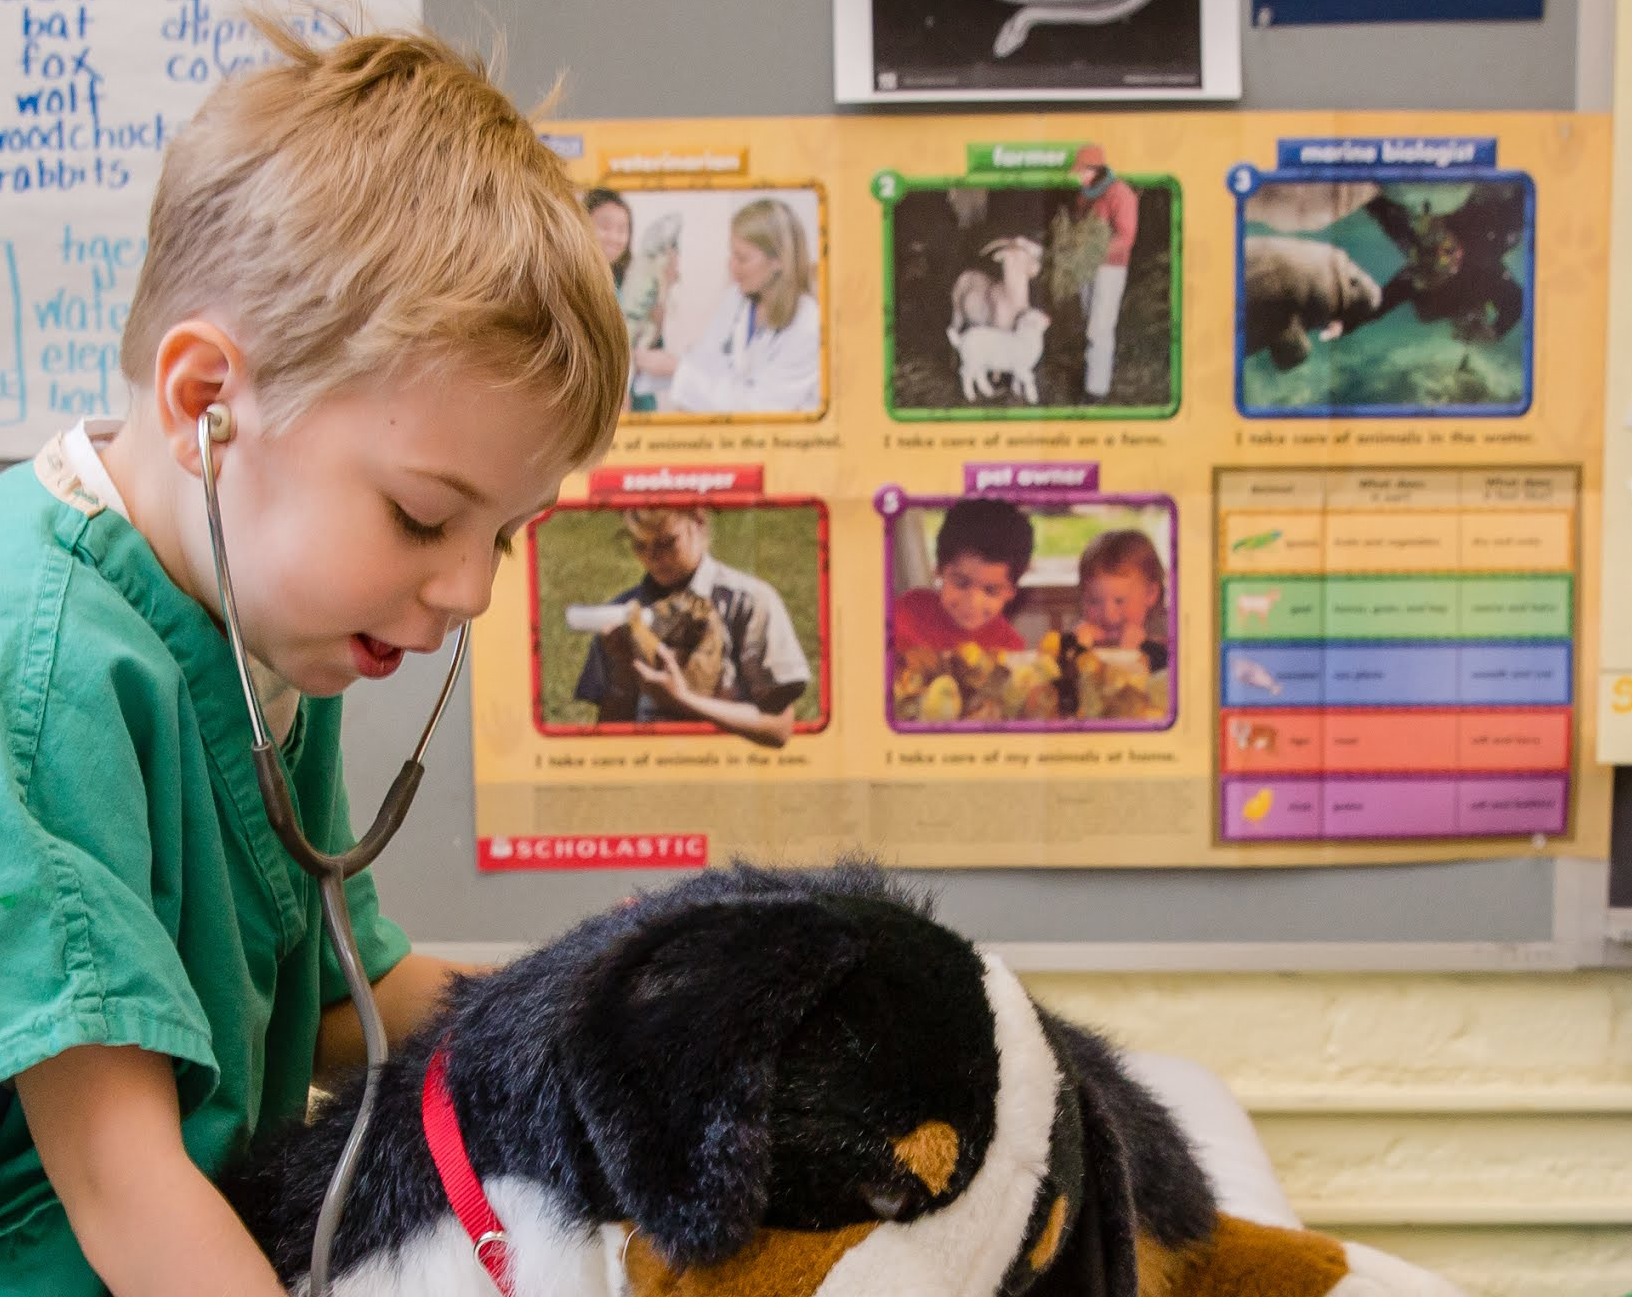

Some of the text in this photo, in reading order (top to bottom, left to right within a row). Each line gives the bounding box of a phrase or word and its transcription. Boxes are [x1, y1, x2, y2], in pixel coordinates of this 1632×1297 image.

[22, 6, 94, 40] bat
[21, 42, 104, 84] fox
[15, 82, 106, 130] wolf
[609, 150, 741, 174] veterinarian
[992, 146, 1067, 168] farmer
[1300, 144, 1475, 168] marine biologist
[1235, 172, 1250, 193] 3
[1005, 434, 1071, 449] animals
[1356, 431, 1422, 446] animals
[622, 472, 737, 494] zookeeper
[976, 469, 1088, 491] pet owner
[655, 753, 719, 768] animals
[1037, 750, 1100, 766] animals
[516, 836, 705, 860] SCHOLASTIC
